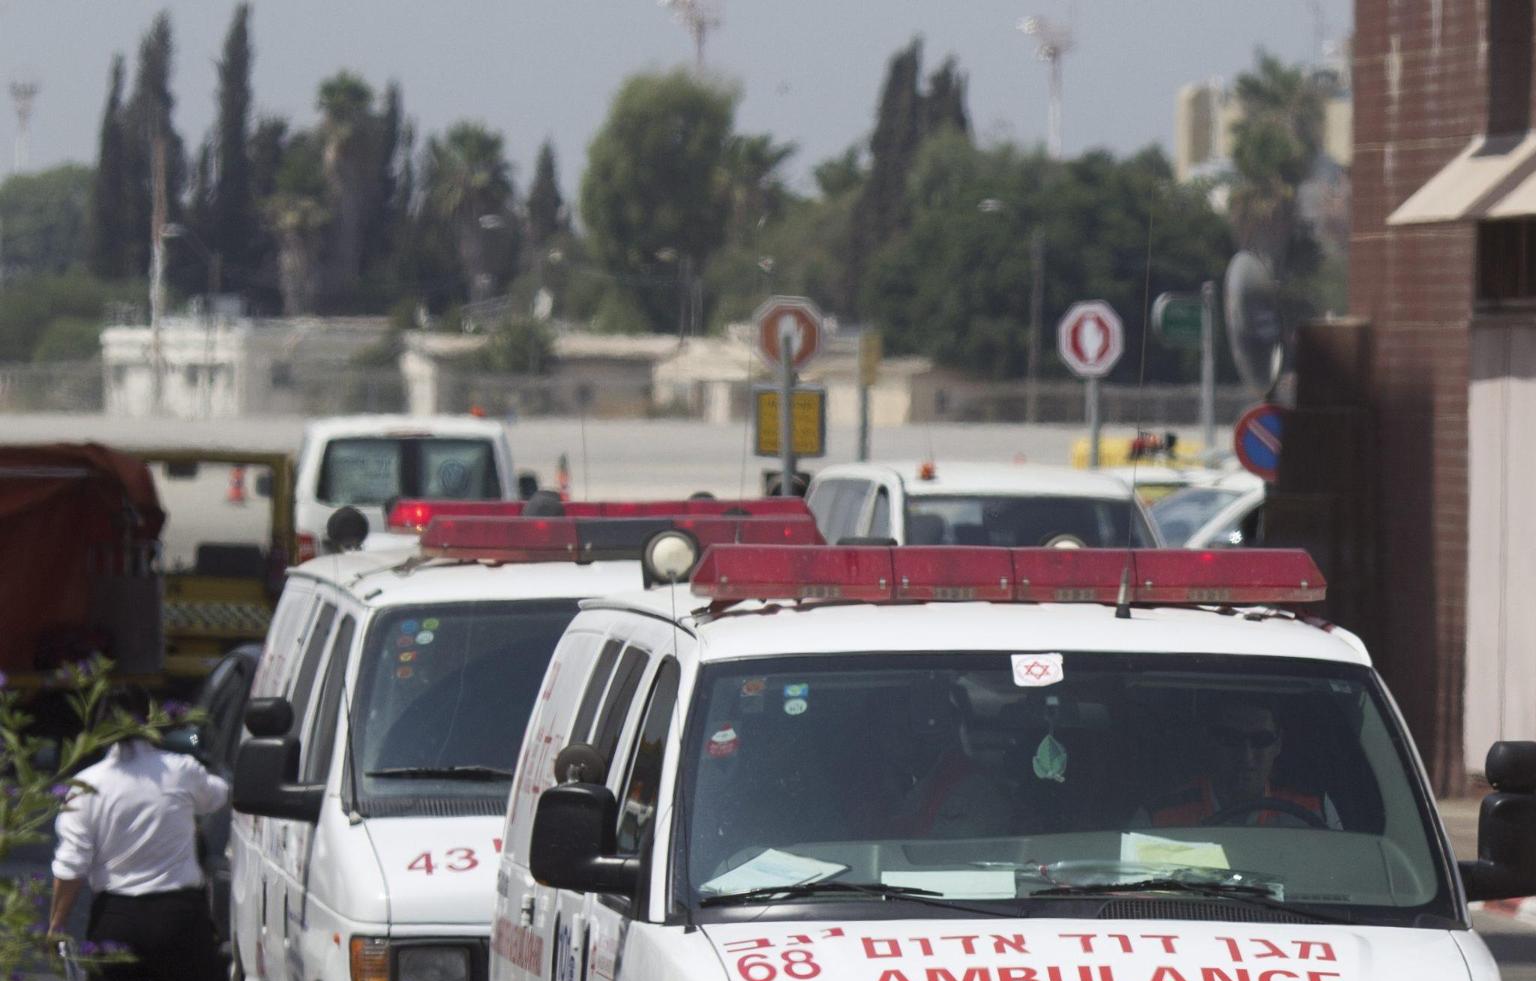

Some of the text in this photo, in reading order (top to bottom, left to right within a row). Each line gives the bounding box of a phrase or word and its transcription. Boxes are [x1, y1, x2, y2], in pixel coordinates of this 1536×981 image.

[406, 846, 479, 876] 43
[860, 933, 1338, 963] מגן דוד אדום
